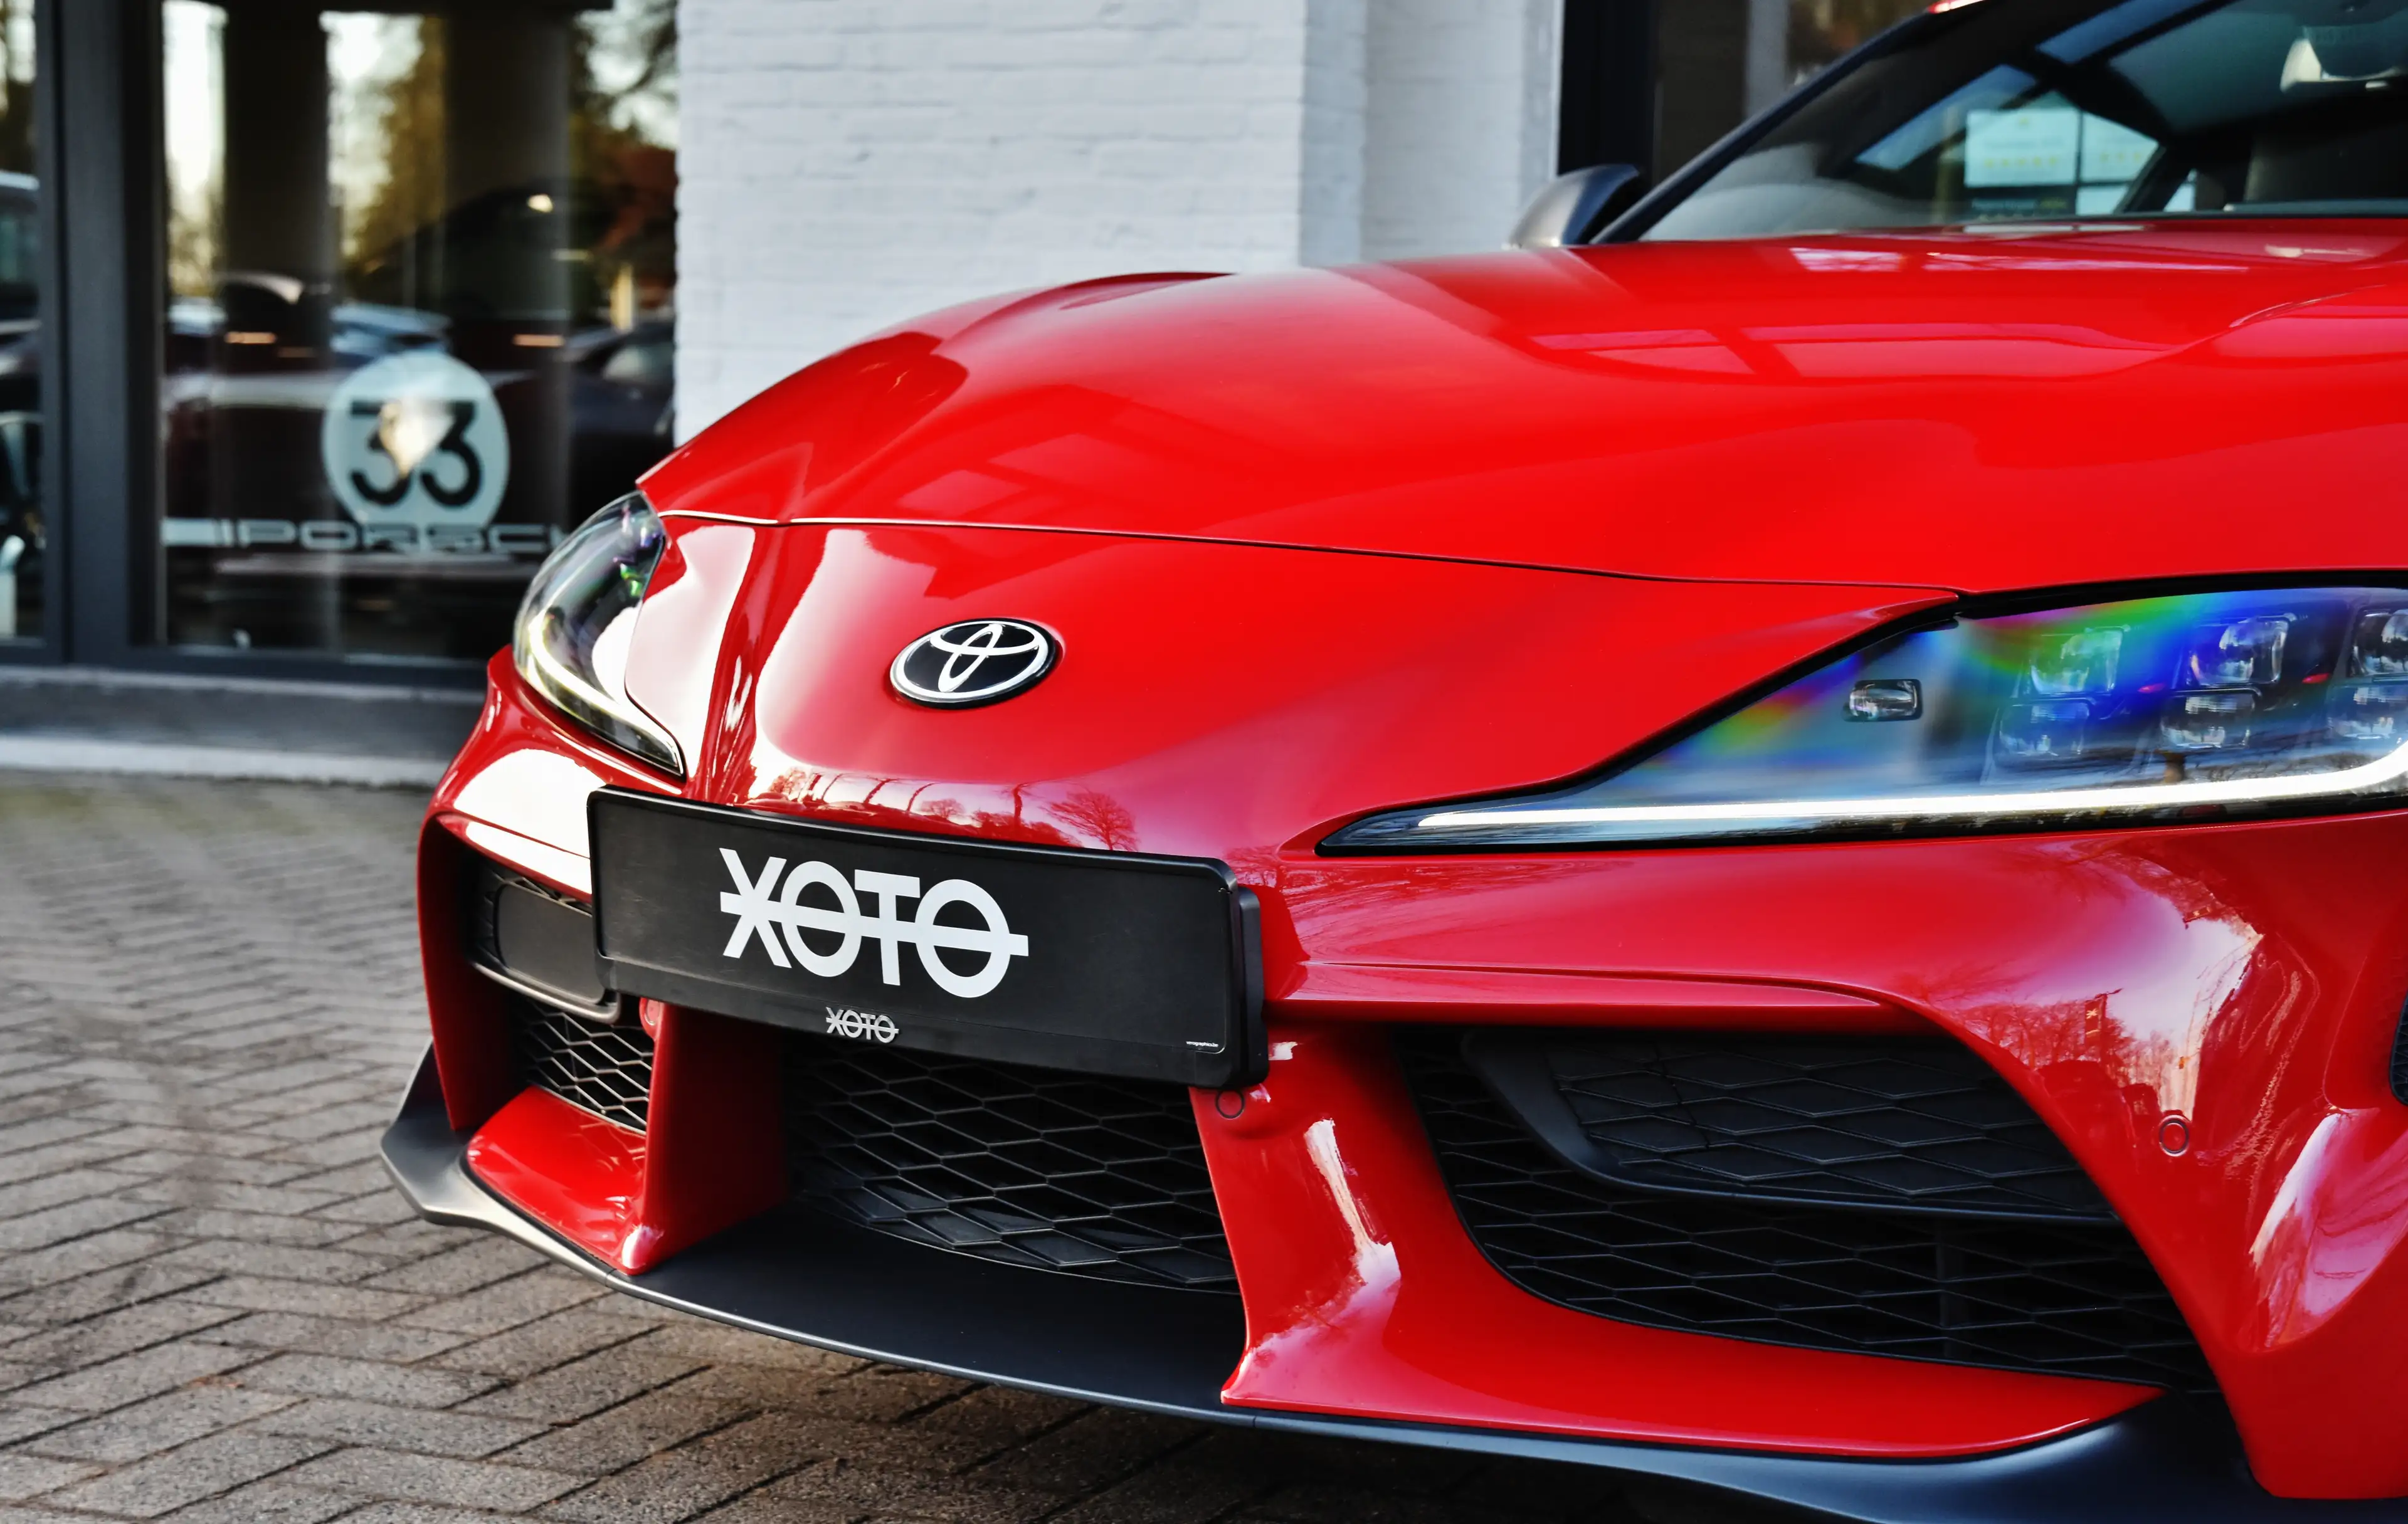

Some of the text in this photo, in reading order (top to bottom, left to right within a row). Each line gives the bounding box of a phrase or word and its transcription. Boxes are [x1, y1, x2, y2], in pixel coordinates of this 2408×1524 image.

[349, 399, 482, 507] 33
[236, 518, 568, 554] PORSC
[719, 848, 1029, 998] XOTO
[825, 1006, 899, 1043] XOTO
